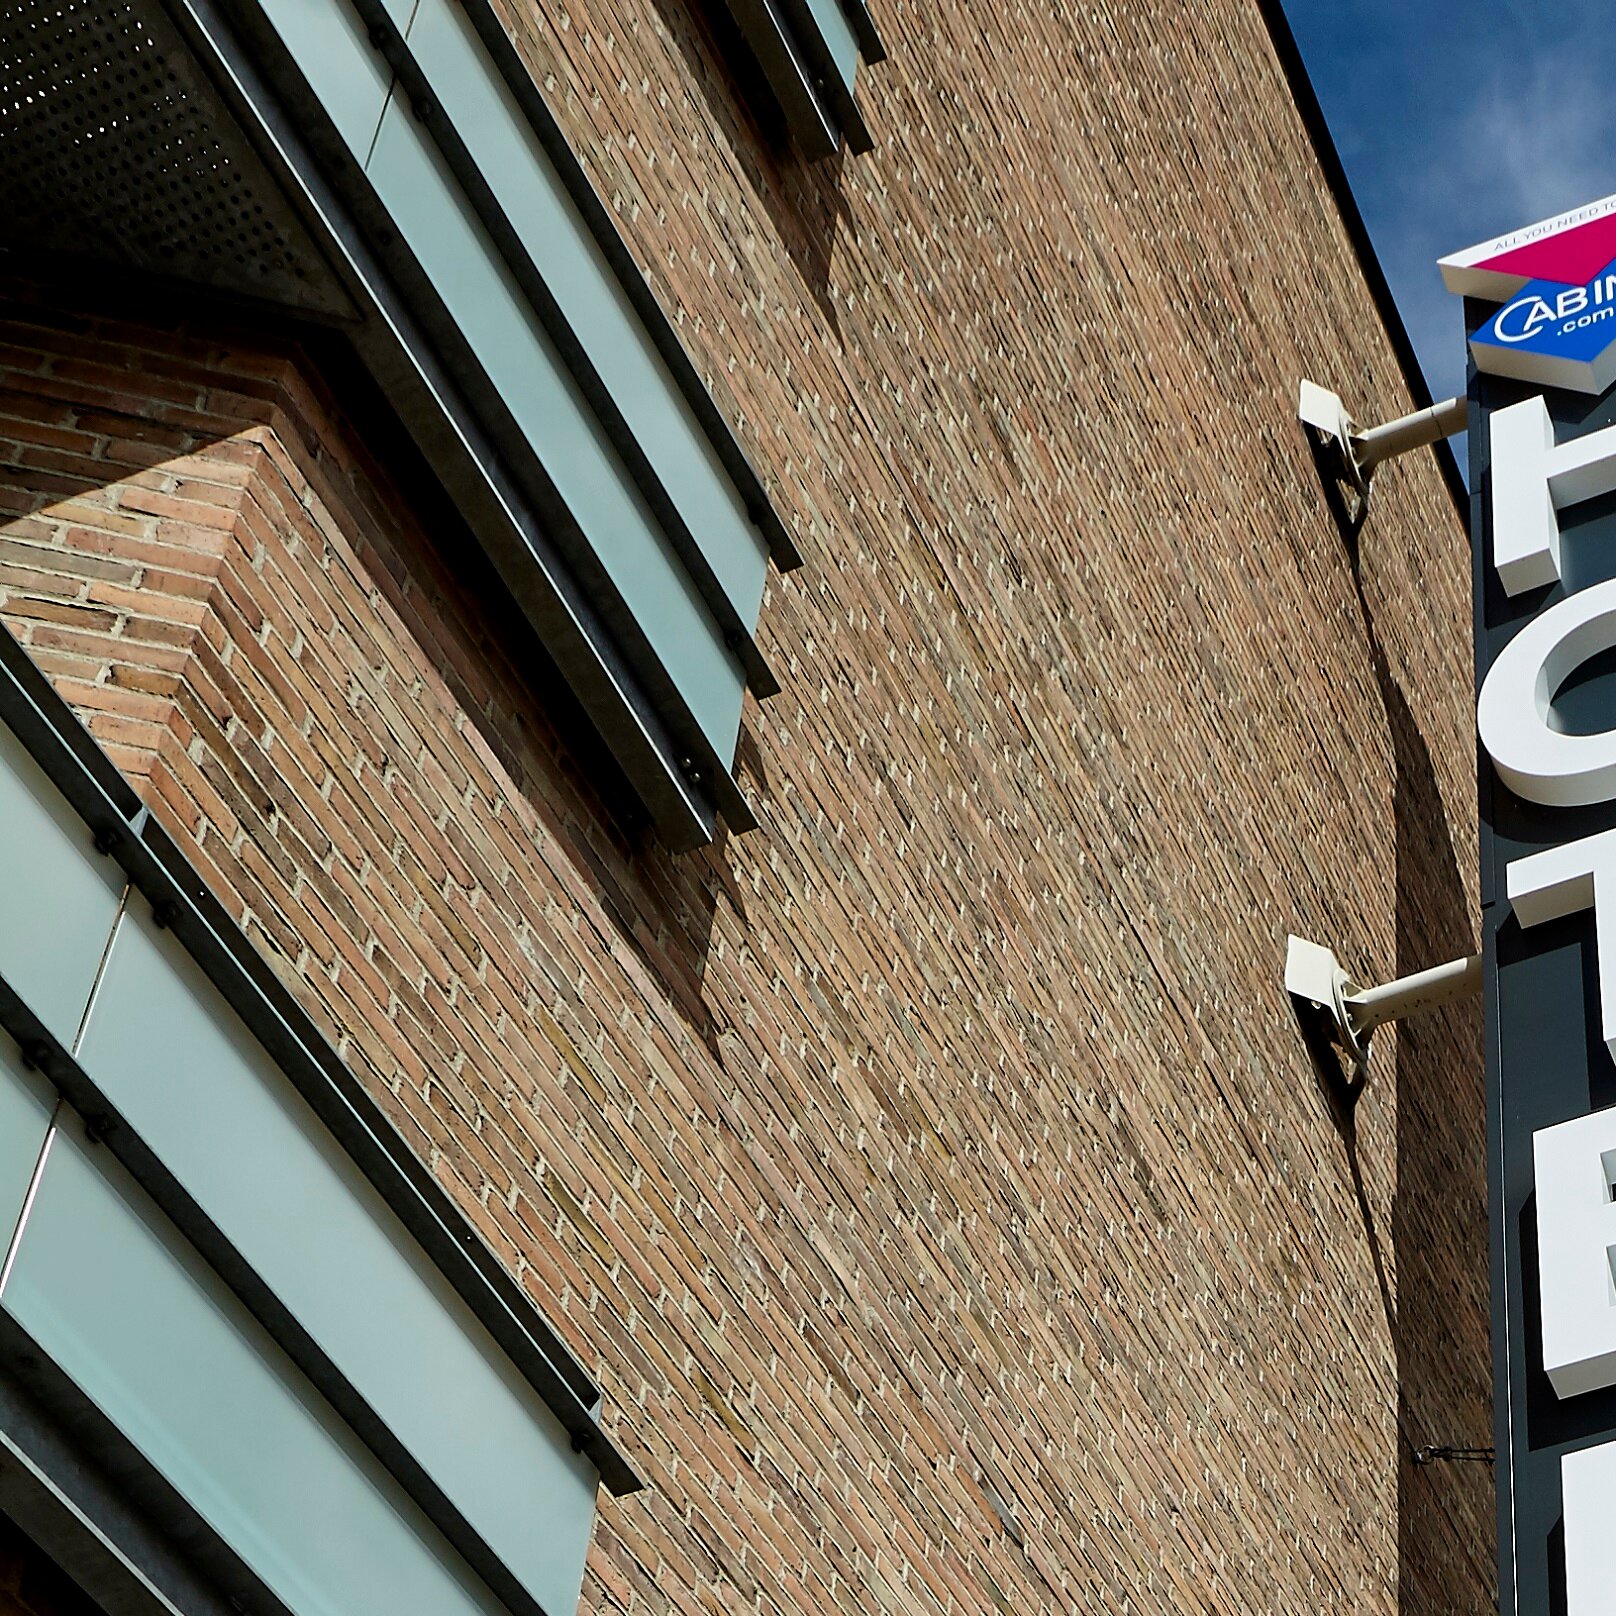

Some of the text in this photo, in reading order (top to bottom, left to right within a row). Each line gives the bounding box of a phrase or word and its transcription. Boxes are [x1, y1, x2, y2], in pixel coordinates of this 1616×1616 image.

[1494, 236, 1521, 252] ALL
[1523, 225, 1553, 241] YOU
[1557, 208, 1599, 228] NEED
[1555, 305, 1615, 337] .com
